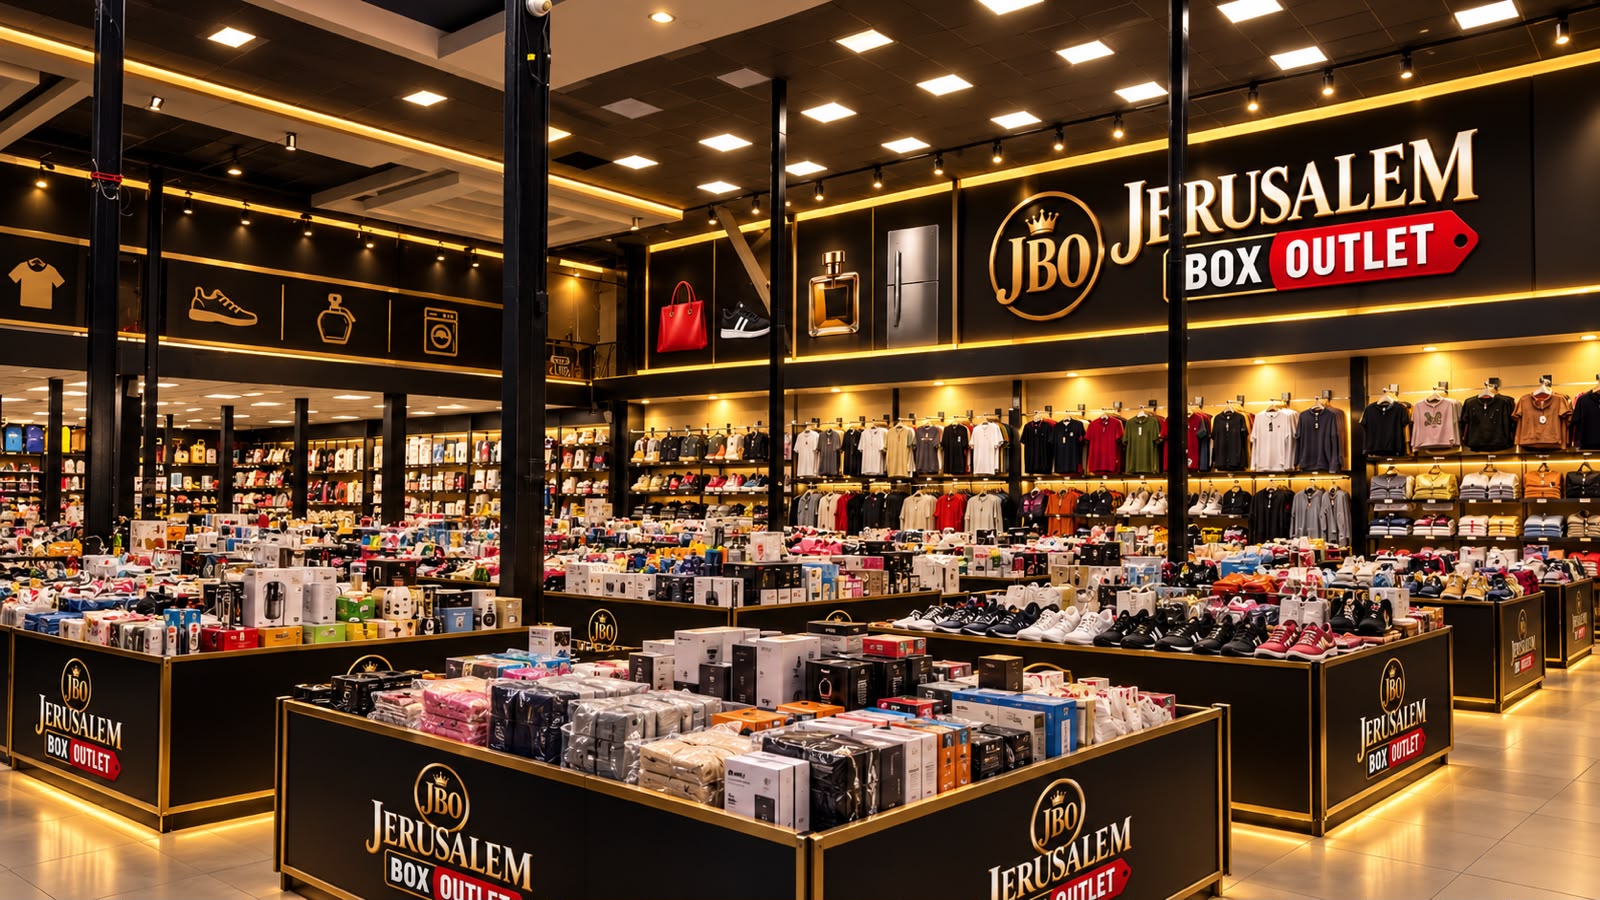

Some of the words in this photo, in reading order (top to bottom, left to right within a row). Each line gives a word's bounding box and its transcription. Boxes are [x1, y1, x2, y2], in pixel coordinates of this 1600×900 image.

[1110, 128, 1479, 266] JERUSALEM
[996, 232, 1088, 305] JBO
[1185, 244, 1263, 291] BOX
[1285, 223, 1435, 279] OUTLET
[591, 621, 614, 642] JBO
[64, 675, 88, 702] JBO
[1383, 676, 1403, 706] JBO
[35, 694, 122, 751] JERUSALEM
[1357, 698, 1427, 763] JERUSALEM
[48, 734, 68, 759] BOX
[73, 743, 111, 774] OUTLET
[1368, 746, 1388, 775] BOX
[1391, 732, 1420, 763] OUTLET
[420, 783, 463, 820] JBO
[365, 799, 533, 892] JERUSALEM
[1038, 803, 1078, 845] JBO
[390, 857, 430, 894] BOX
[439, 874, 511, 900] OUT
[988, 816, 1132, 900] JERUSALEM
